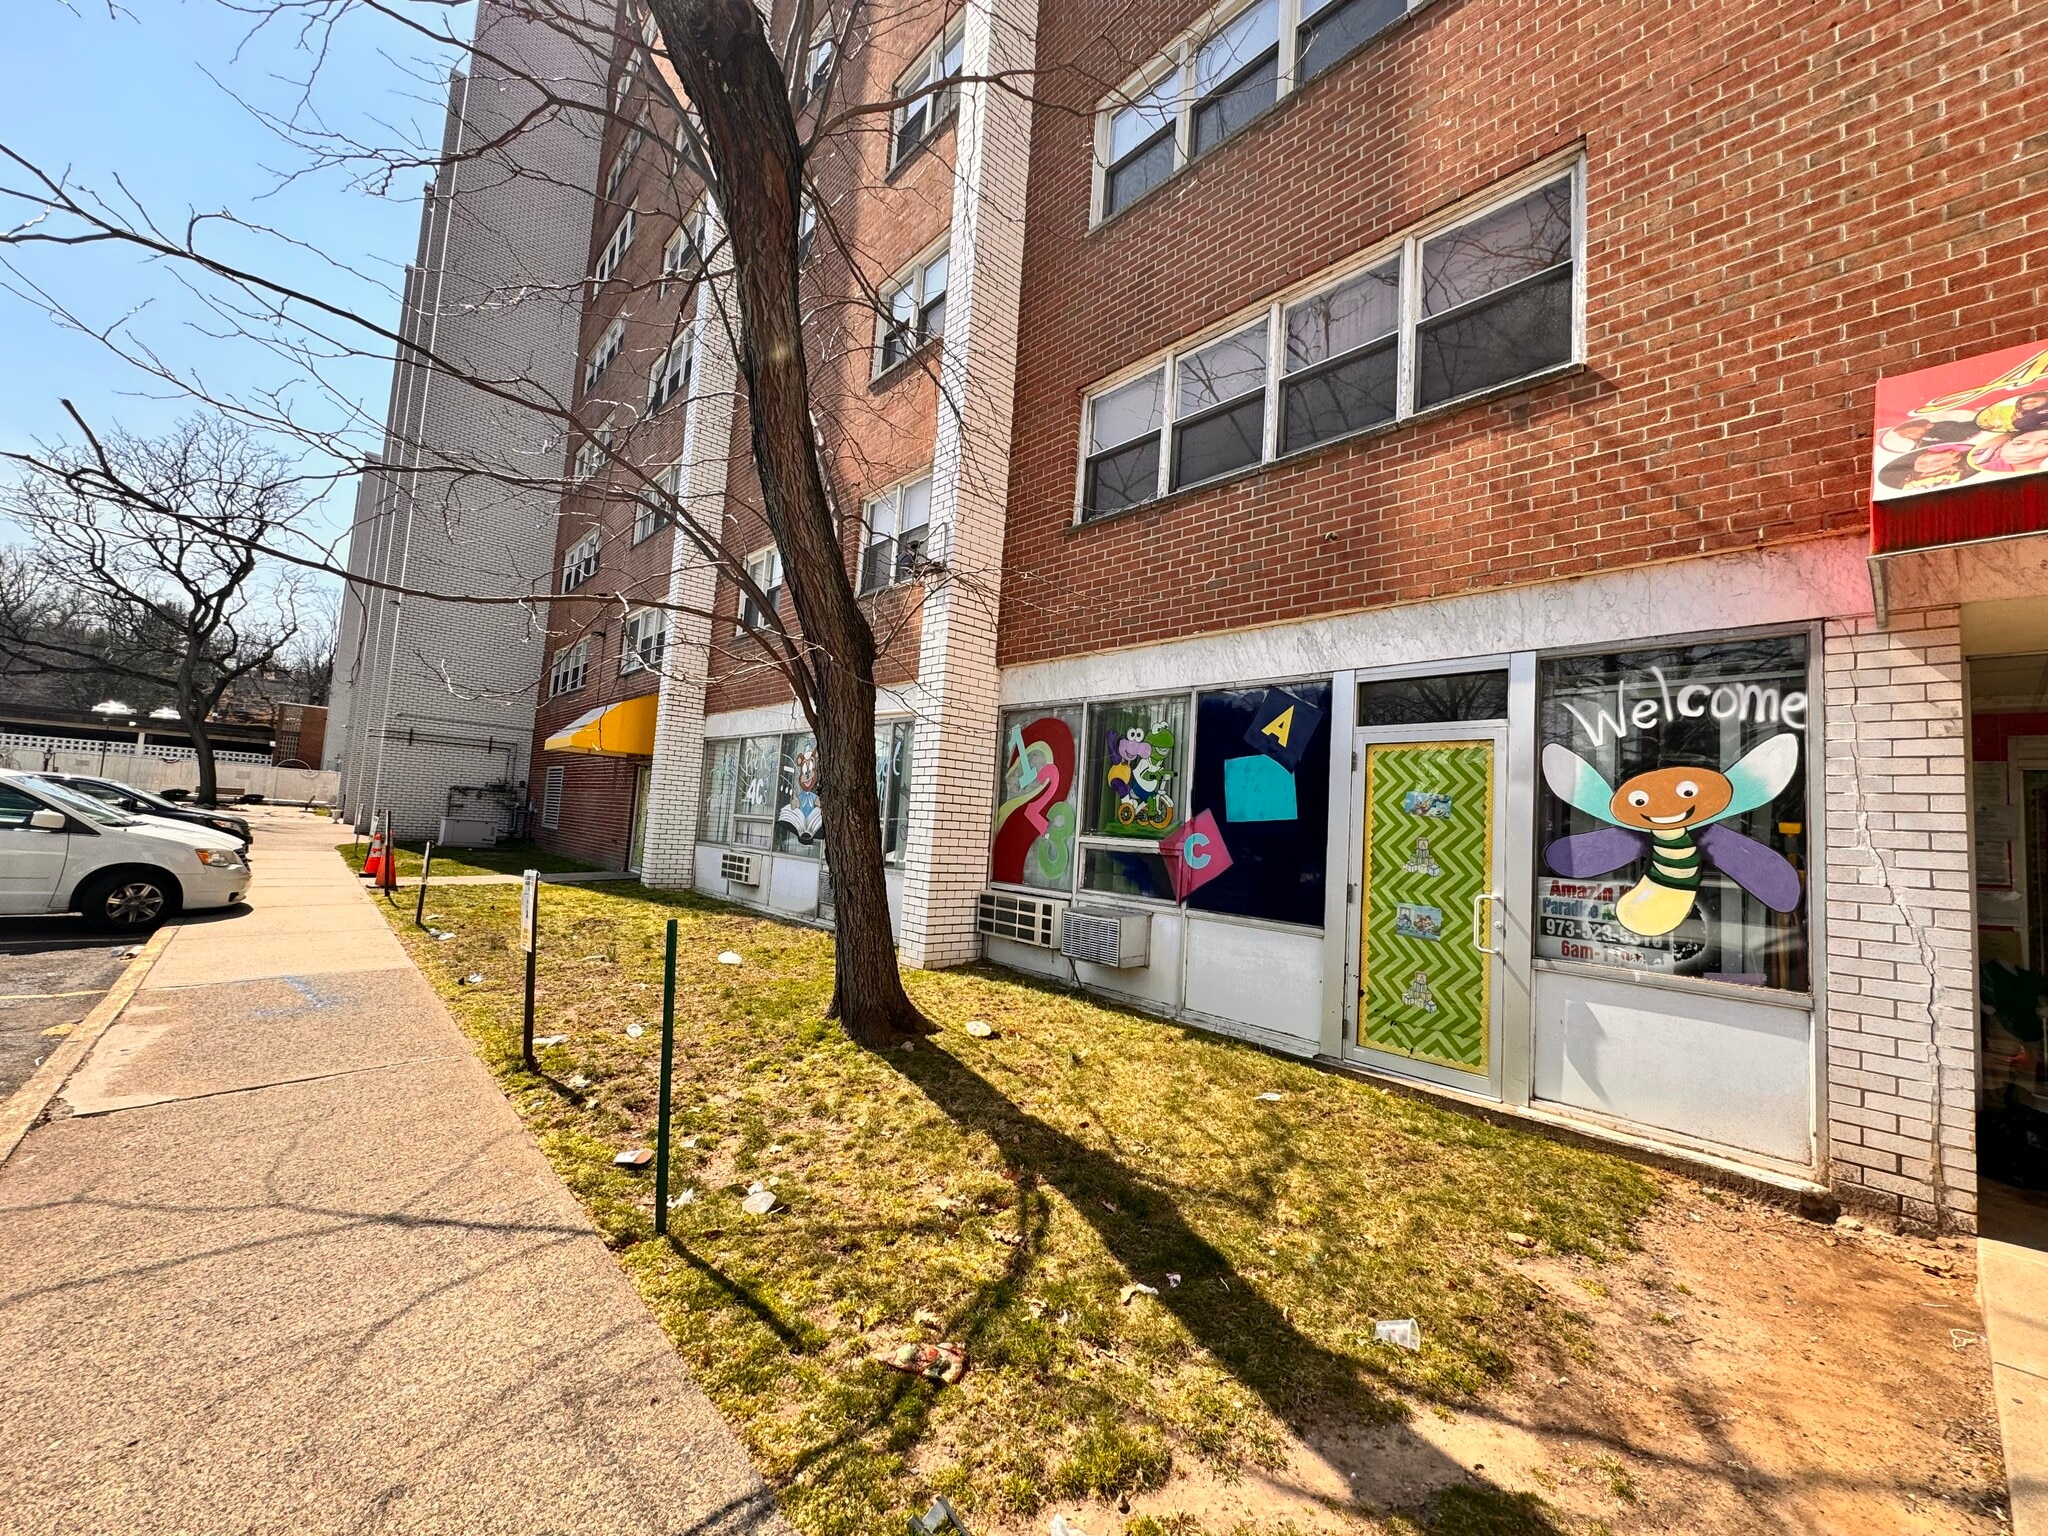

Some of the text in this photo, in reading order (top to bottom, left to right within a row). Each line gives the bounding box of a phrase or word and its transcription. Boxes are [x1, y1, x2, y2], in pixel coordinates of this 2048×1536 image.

[1261, 704, 1295, 748] A
[1561, 666, 1806, 747] Welcome
[1008, 723, 1037, 789] 1
[1183, 832, 1212, 870] C
[1543, 897, 1599, 919] Paradie
